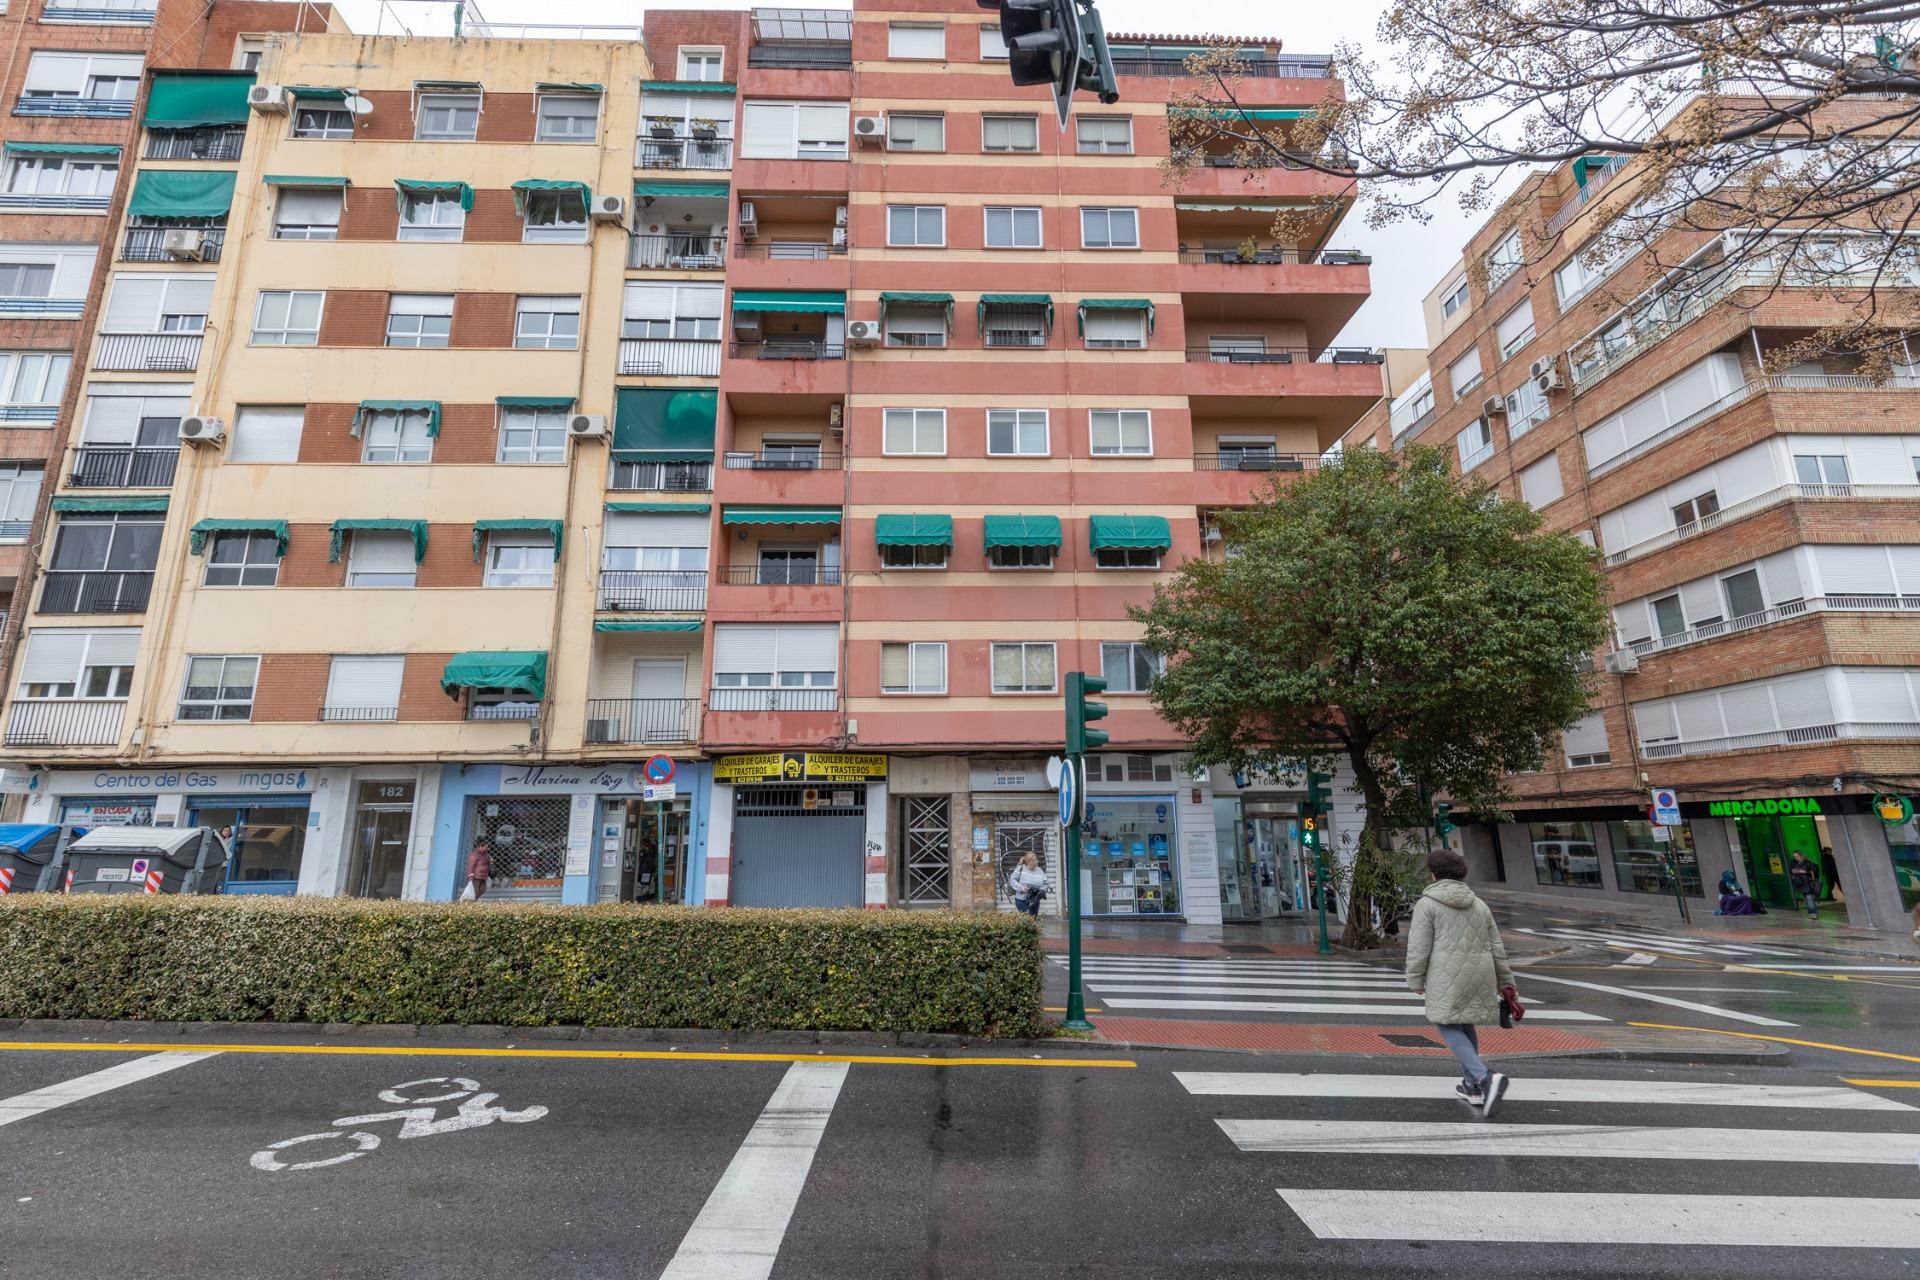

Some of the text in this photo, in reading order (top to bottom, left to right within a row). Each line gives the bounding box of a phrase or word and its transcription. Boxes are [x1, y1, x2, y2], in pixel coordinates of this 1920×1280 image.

[717, 755, 780, 767] ALQUILER DE GARAJES
[808, 755, 883, 765] ALQUILER DE GARAJES
[504, 765, 582, 787] Marina
[733, 767, 768, 775] TRASTEROS
[830, 766, 870, 774] TRASTEROS
[94, 771, 218, 788] Centro del Gas
[239, 771, 296, 791] imgas
[379, 786, 404, 797] 182
[1709, 798, 1821, 815] MERCADONA
[1304, 818, 1315, 830] 15
